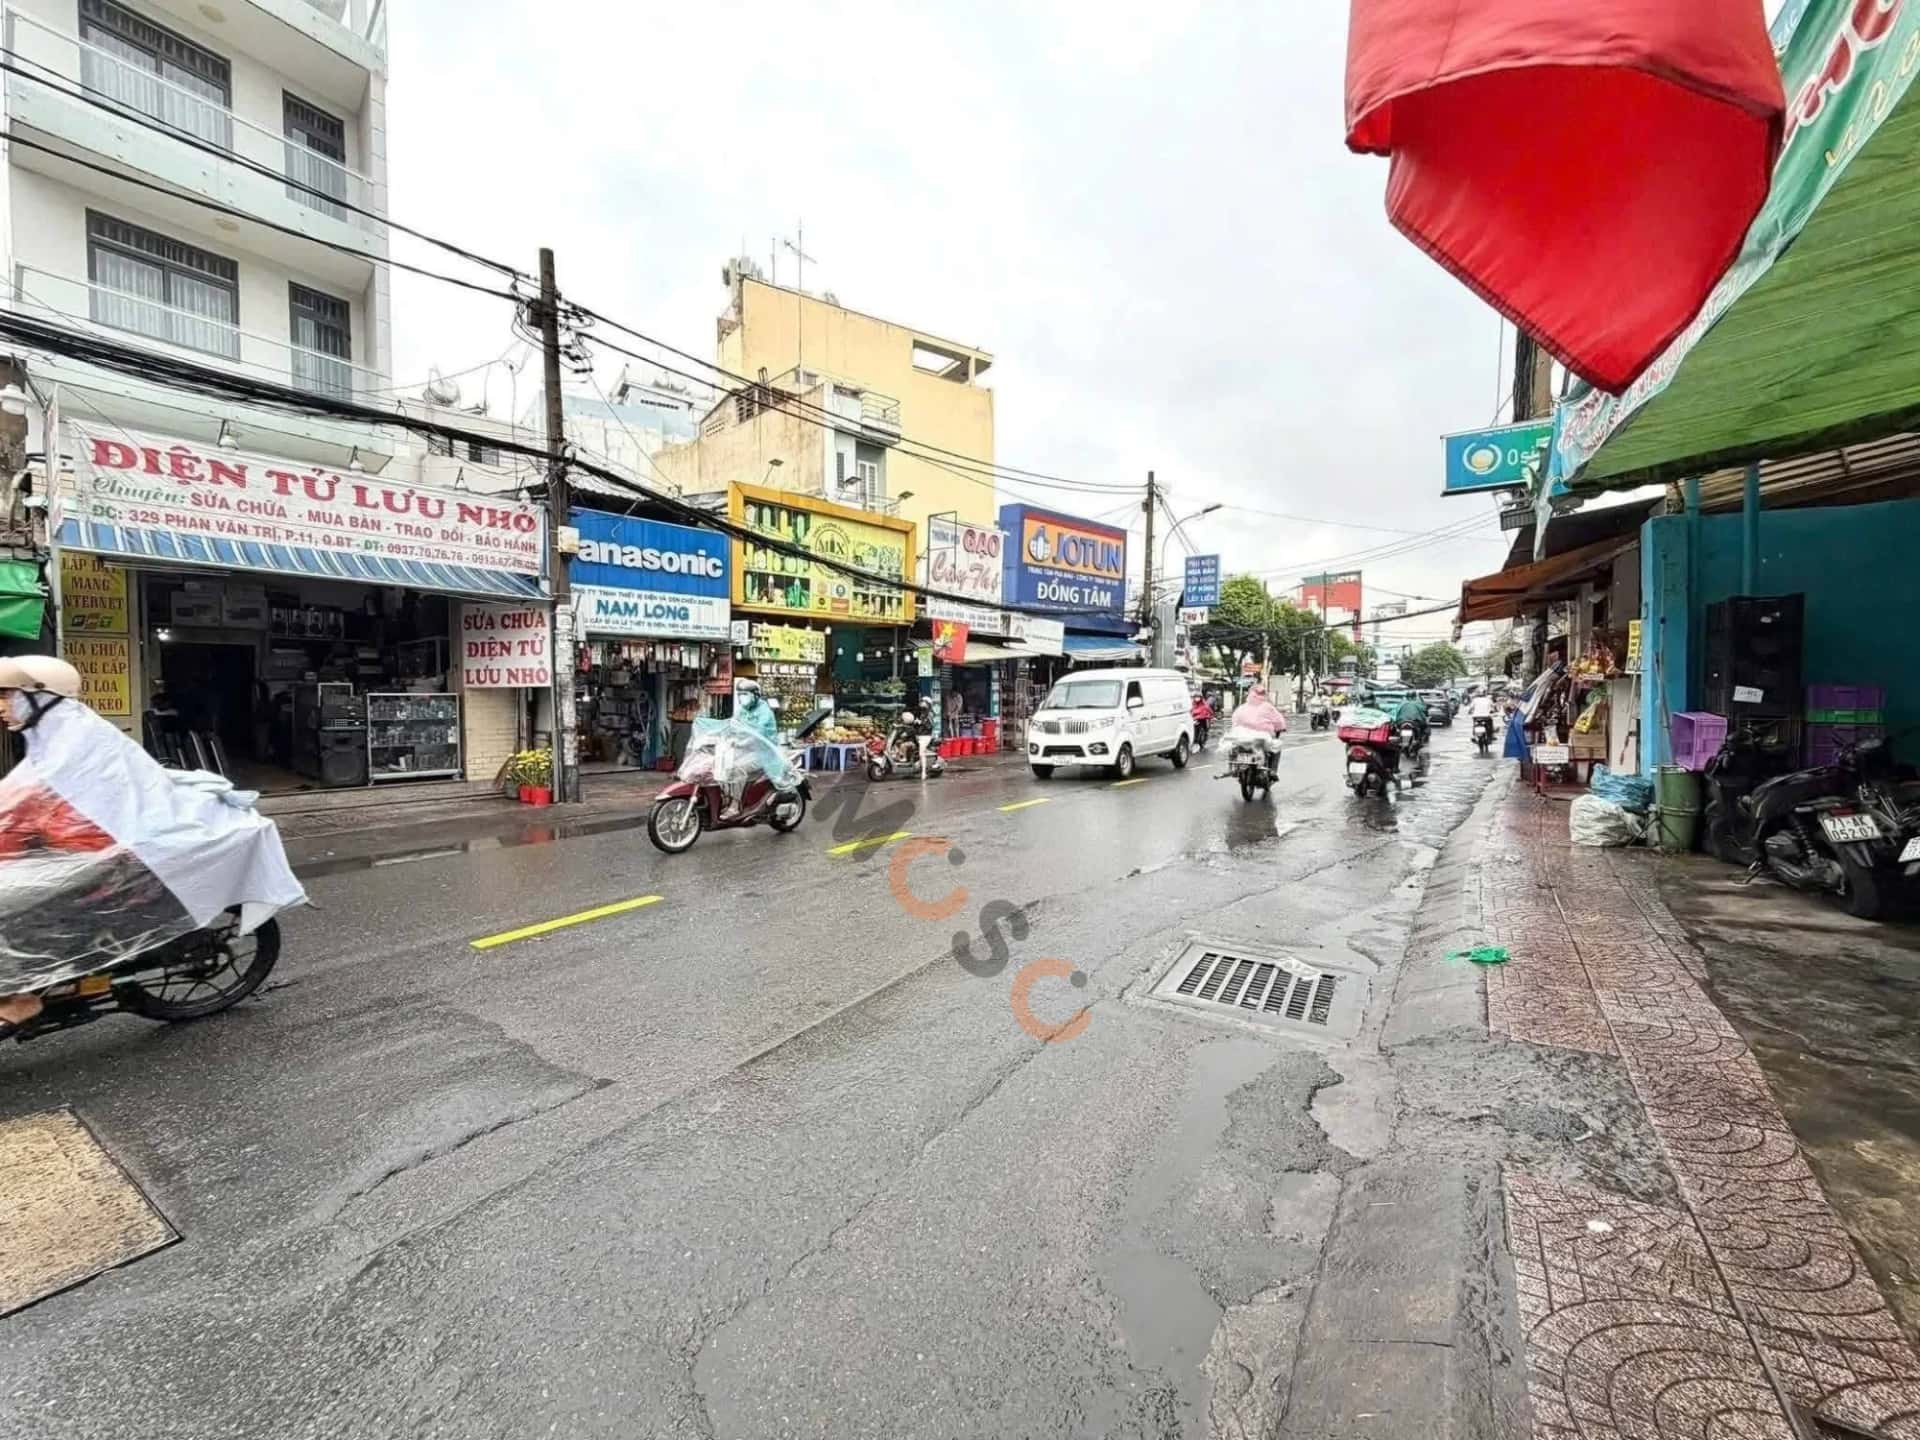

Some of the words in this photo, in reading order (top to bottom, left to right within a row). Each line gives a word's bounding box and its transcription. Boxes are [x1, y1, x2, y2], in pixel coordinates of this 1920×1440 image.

[90, 438, 248, 488] ĐIỆN
[265, 468, 341, 502] TỬ
[352, 485, 446, 519] LƯU
[456, 502, 537, 533] NHỎ
[129, 509, 159, 524] 329
[165, 514, 210, 531] PHAN
[191, 489, 230, 511] SỬA
[237, 499, 287, 518] CHỮA
[308, 509, 344, 526] MUA
[394, 523, 433, 539] TRAO
[963, 529, 1000, 558] GẠO
[1053, 532, 1121, 574] JOTUN
[577, 539, 724, 578] anasonic
[64, 594, 124, 609] NTERNET
[596, 599, 639, 617] NAM
[644, 602, 690, 621] LONG
[1082, 585, 1112, 608] TÂM
[463, 607, 496, 630] SỬA
[501, 607, 547, 630] CHỮA
[467, 636, 512, 661] ĐIỆN
[517, 632, 545, 656] TỬ
[465, 664, 501, 685] LƯU
[506, 660, 549, 685] NHỎ
